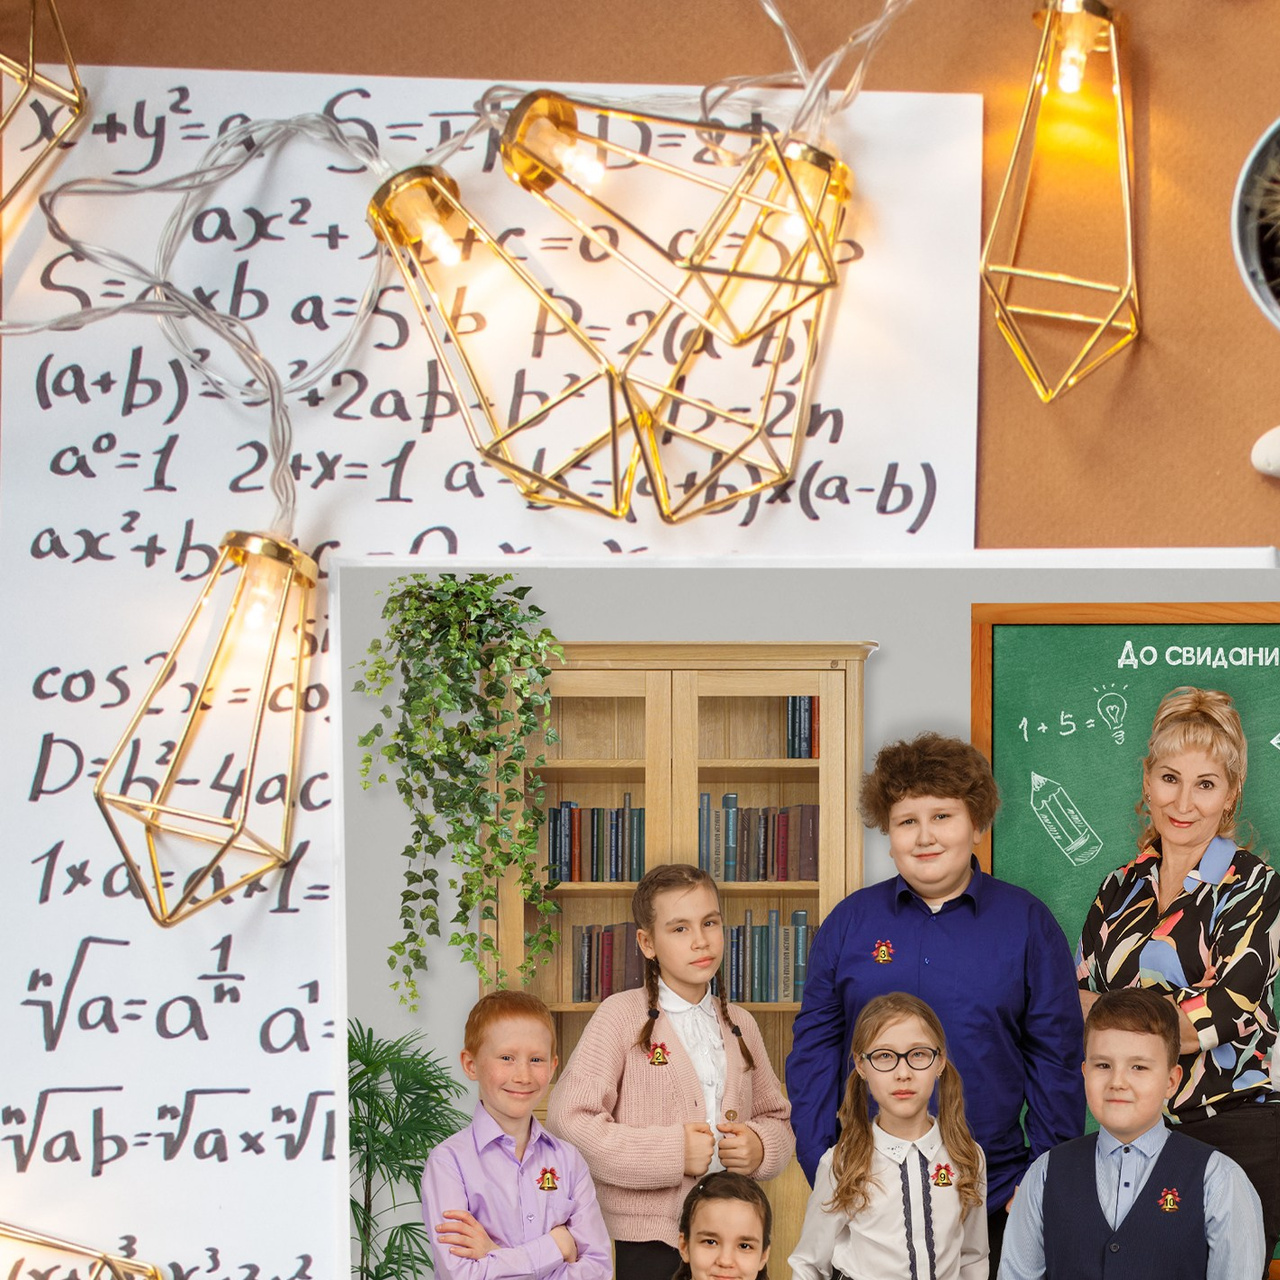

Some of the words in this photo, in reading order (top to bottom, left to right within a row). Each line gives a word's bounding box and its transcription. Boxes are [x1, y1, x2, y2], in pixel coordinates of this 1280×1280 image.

[1117, 641, 1158, 669] До
[1059, 711, 1077, 736] 5
[655, 1052, 662, 1061] 2
[546, 1177, 551, 1186] 1
[939, 1173, 946, 1182] 9
[1164, 1198, 1175, 1208] 10
